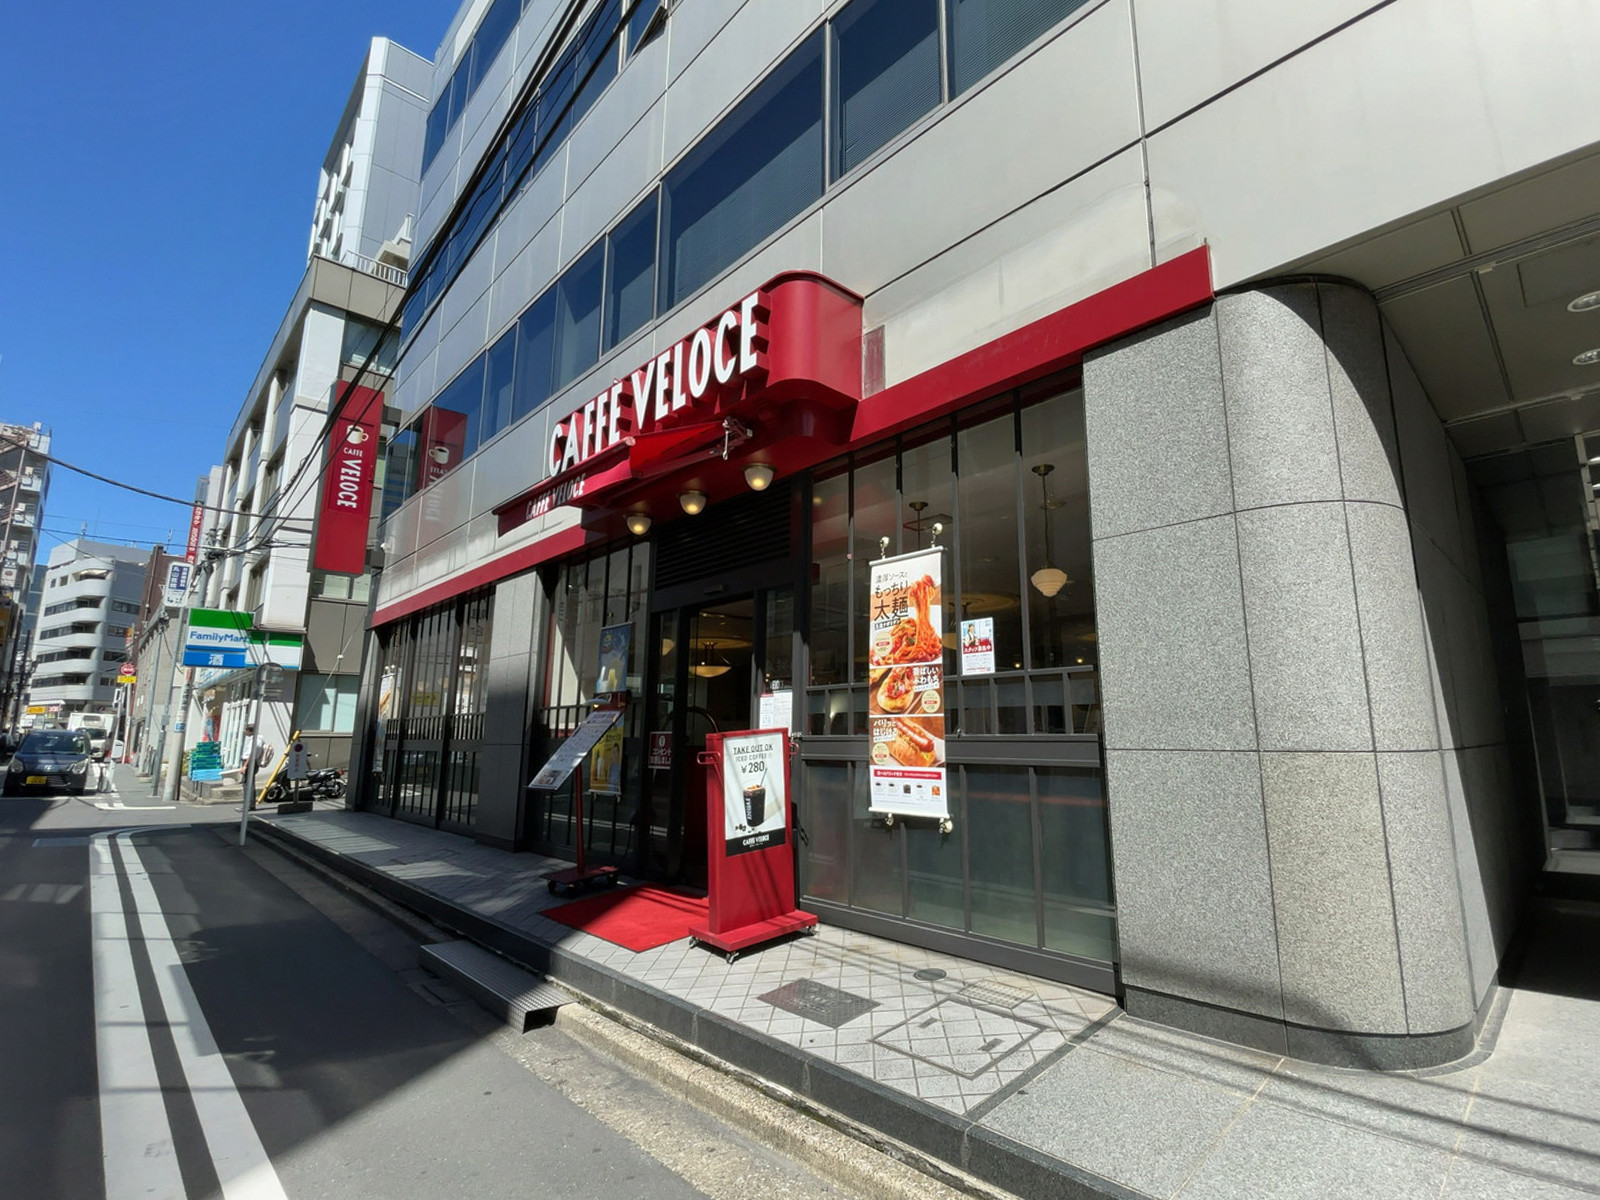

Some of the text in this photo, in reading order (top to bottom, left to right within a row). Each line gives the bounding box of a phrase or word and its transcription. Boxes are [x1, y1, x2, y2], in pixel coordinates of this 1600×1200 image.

[631, 291, 759, 430] VELOCE
[337, 459, 362, 508] VELOCE
[875, 580, 909, 598] もっちり
[874, 596, 909, 621] 太麺
[208, 653, 224, 666] 酒
[733, 746, 749, 755] TAKE
[751, 744, 763, 753] OUT
[749, 753, 767, 761] COFFEE
[741, 761, 765, 774] ¥280
